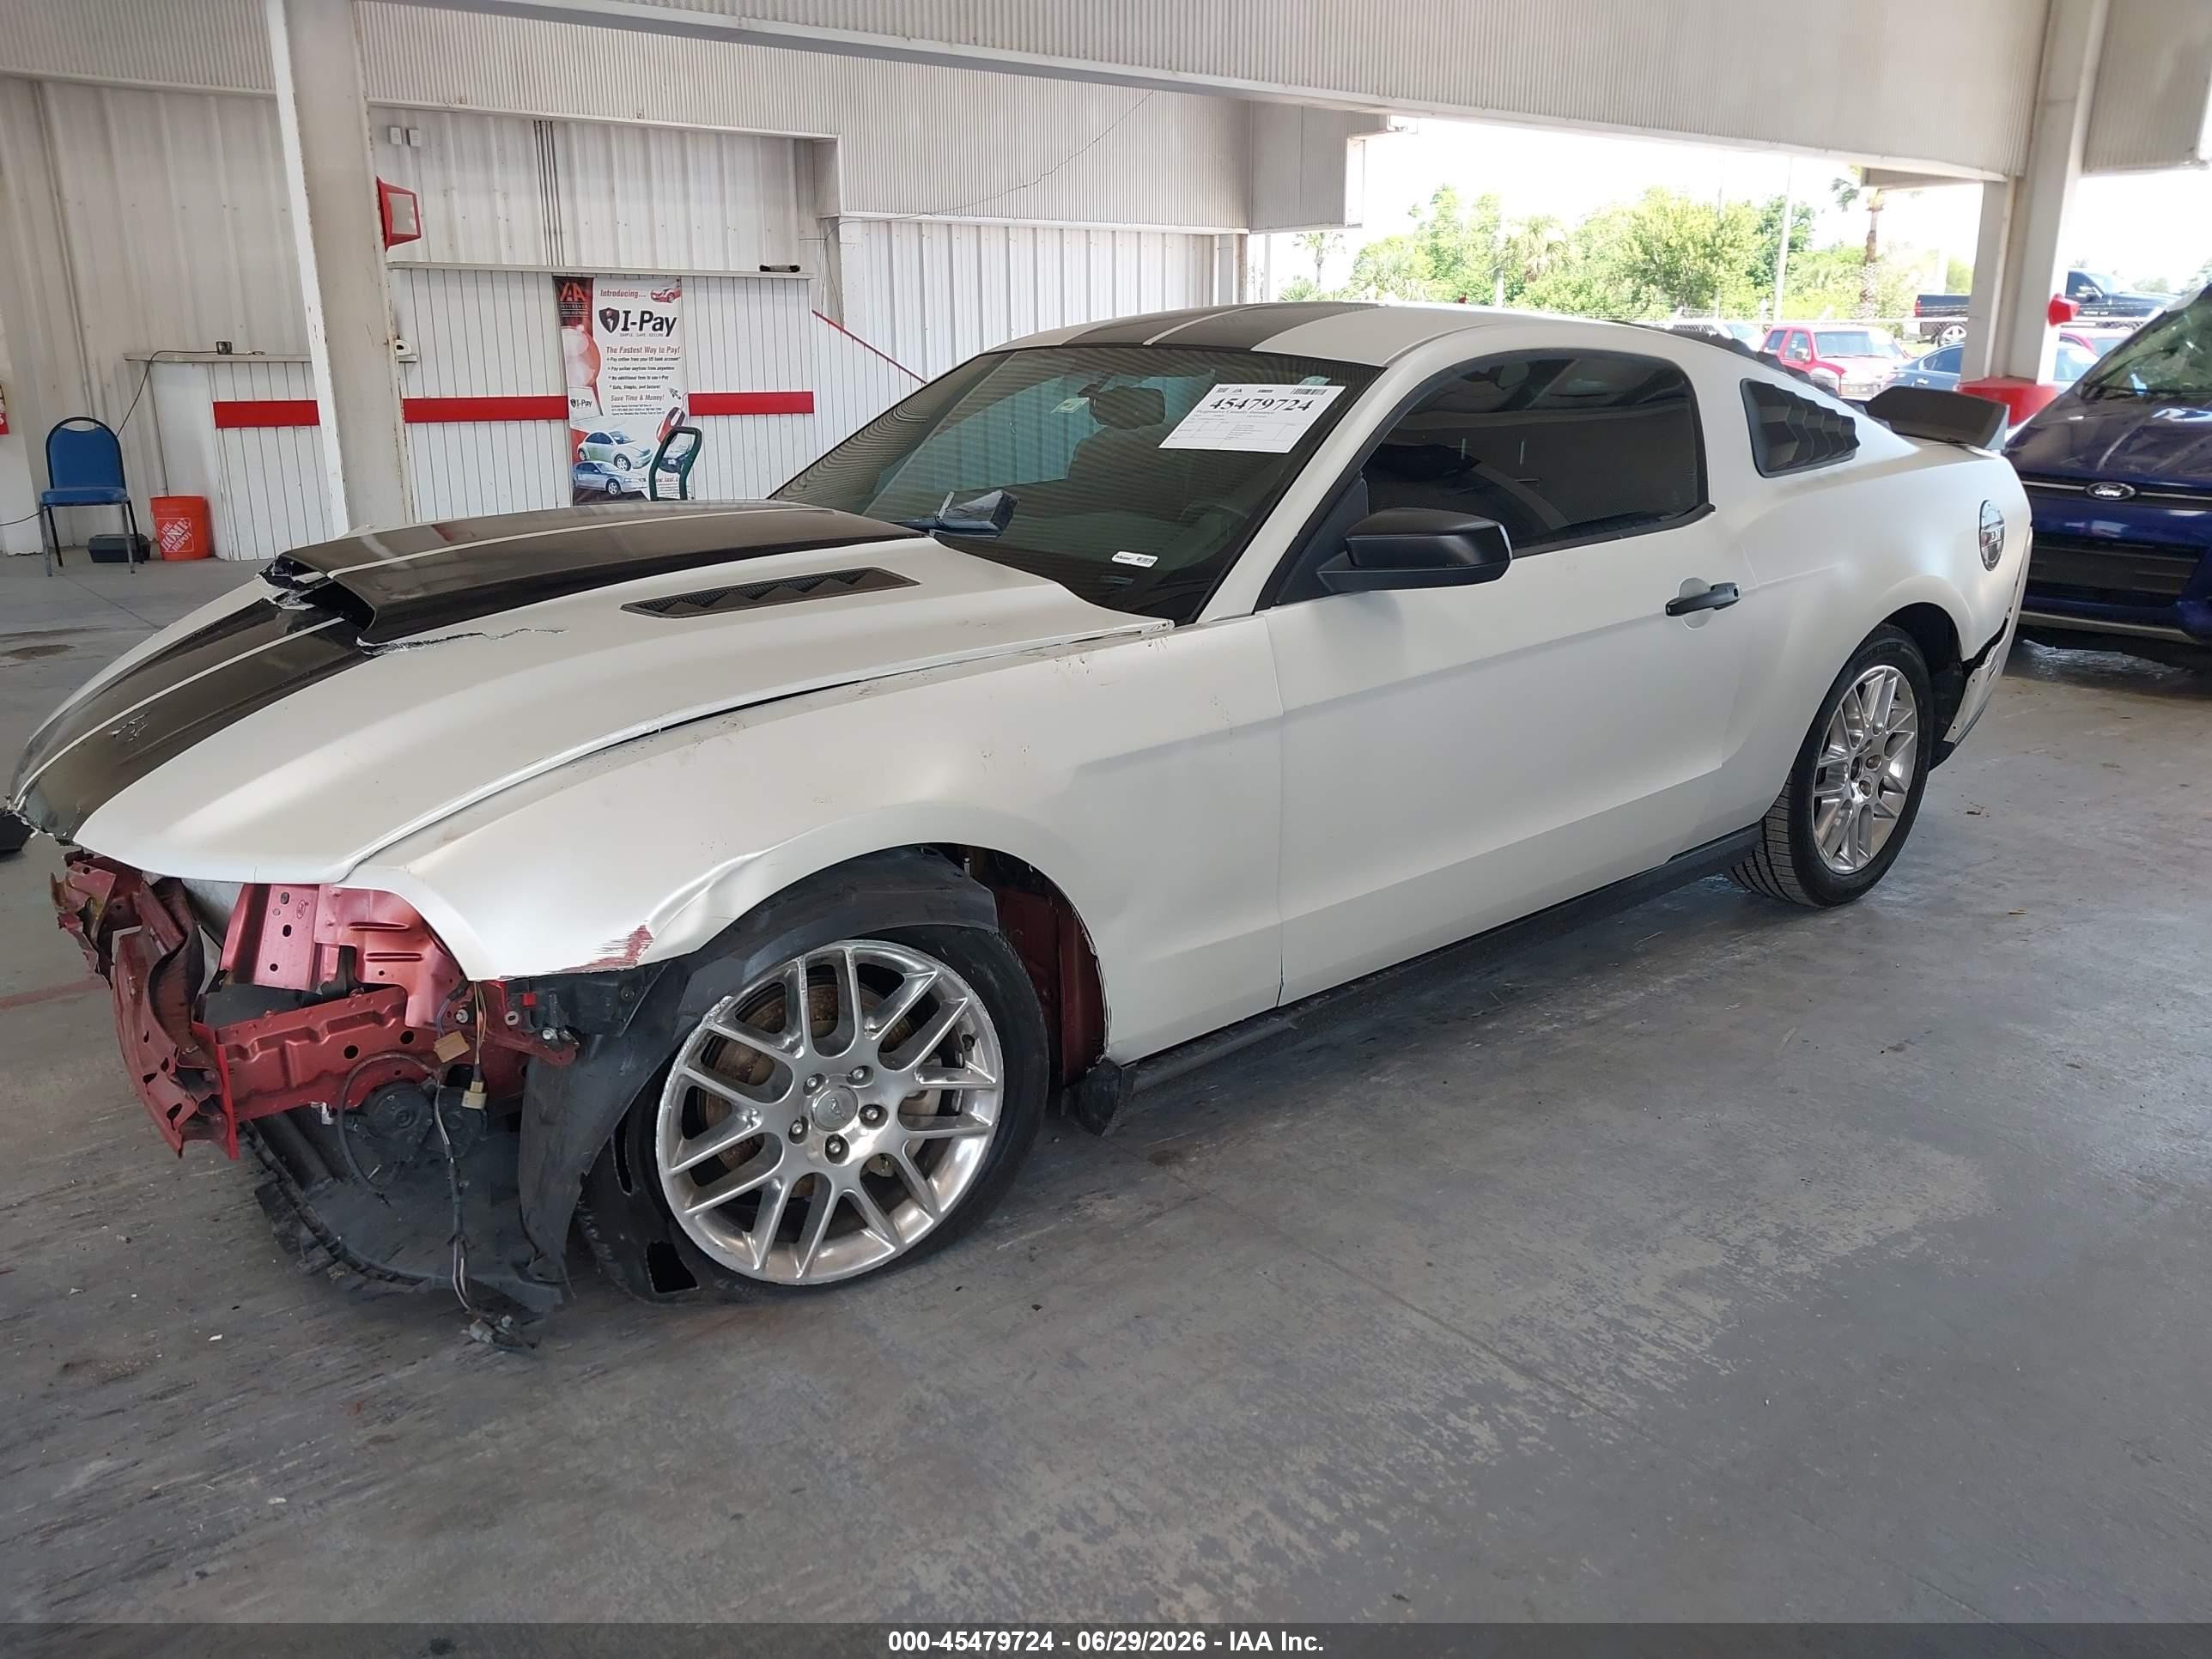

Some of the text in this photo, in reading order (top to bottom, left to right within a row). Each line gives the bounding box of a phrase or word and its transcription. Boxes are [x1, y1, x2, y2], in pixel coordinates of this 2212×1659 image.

[600, 289, 646, 299] Introducing...
[621, 310, 678, 337] I-Pay
[644, 346, 657, 355] Way
[666, 346, 680, 355] Pay!
[1210, 398, 1314, 411] 45479724
[2094, 484, 2124, 496] Ford
[161, 521, 173, 535] THE
[161, 519, 188, 552] HOME
[171, 532, 192, 551] DEPOT
